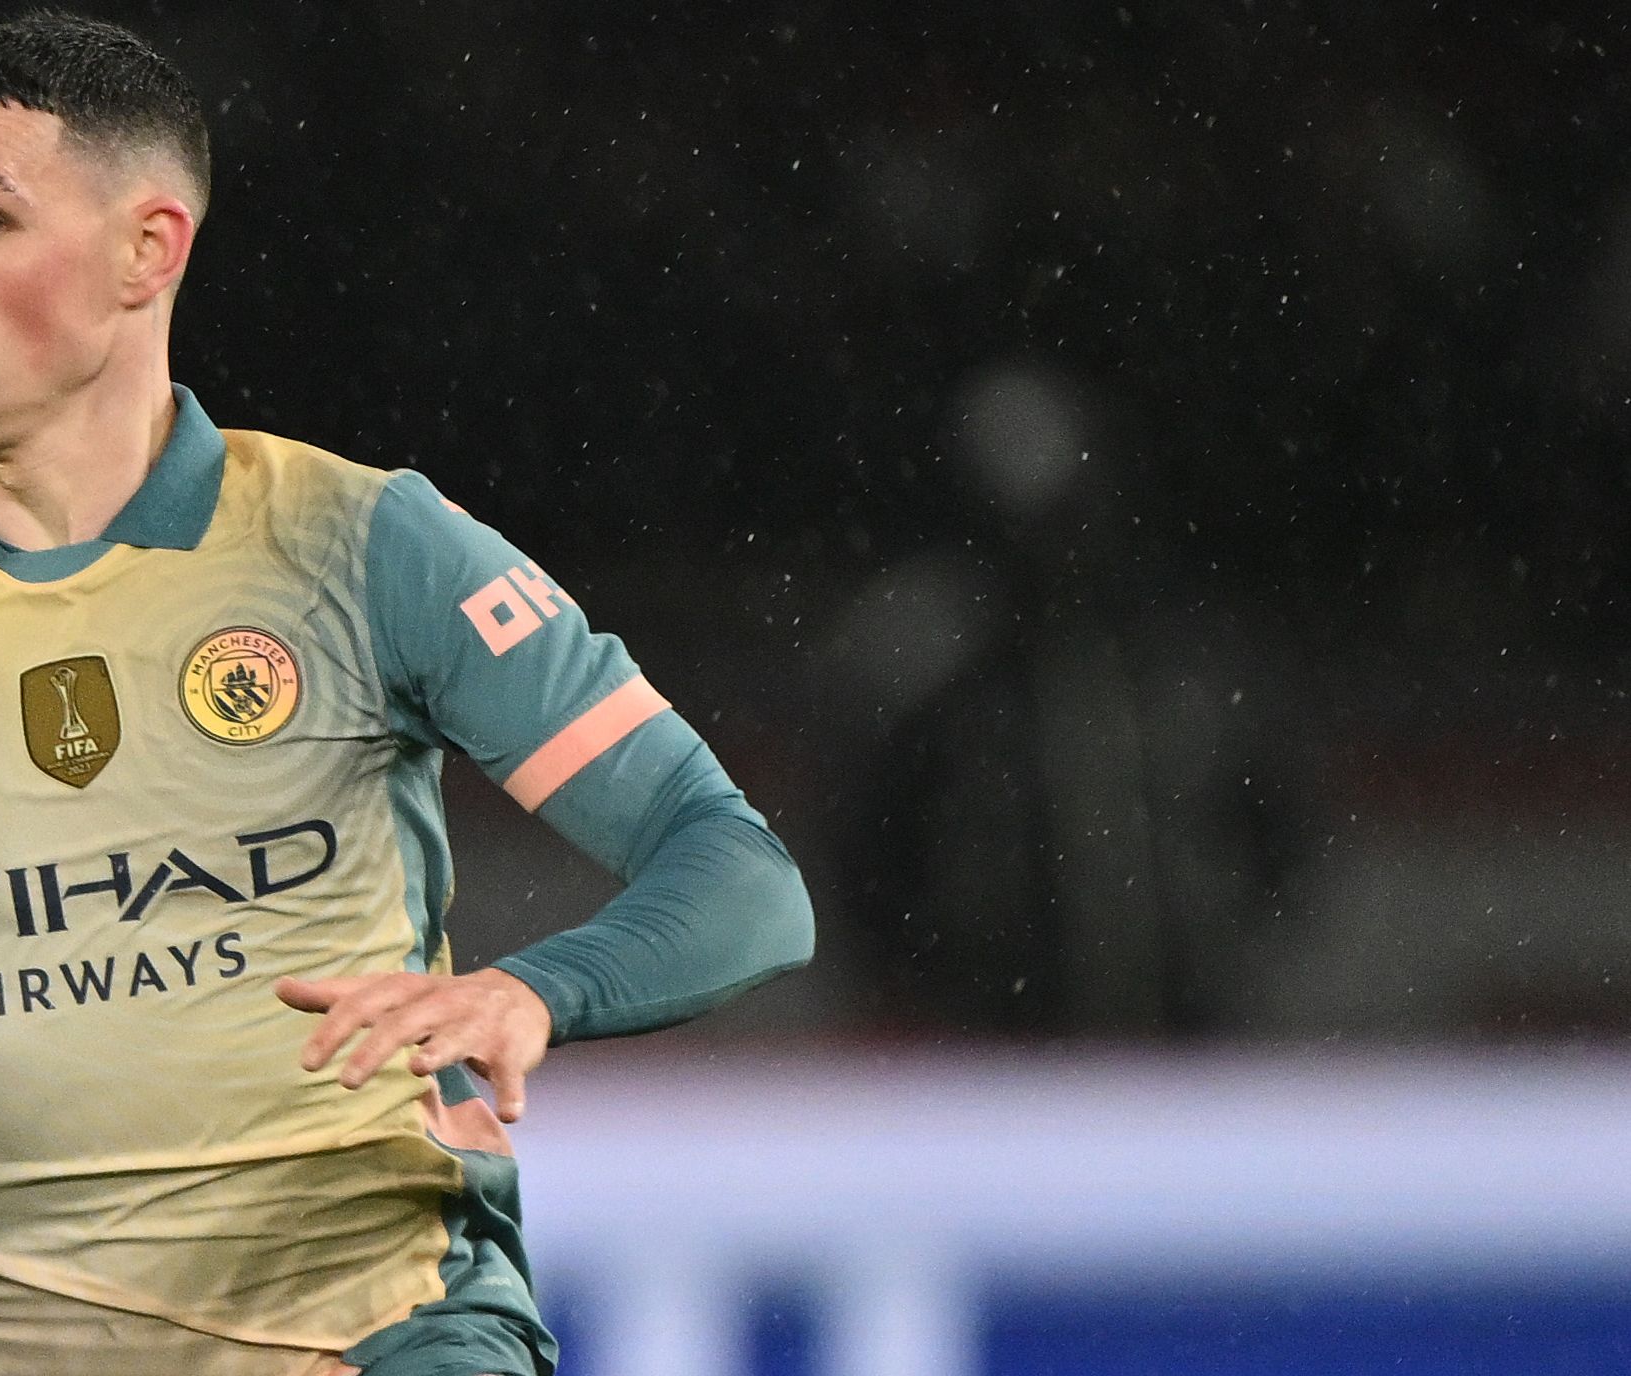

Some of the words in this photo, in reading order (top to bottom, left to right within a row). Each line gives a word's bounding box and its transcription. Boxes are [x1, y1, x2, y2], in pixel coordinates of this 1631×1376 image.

[192, 635, 287, 676] MANCHESTER
[227, 724, 263, 737] CITY
[54, 737, 100, 760] FIFA
